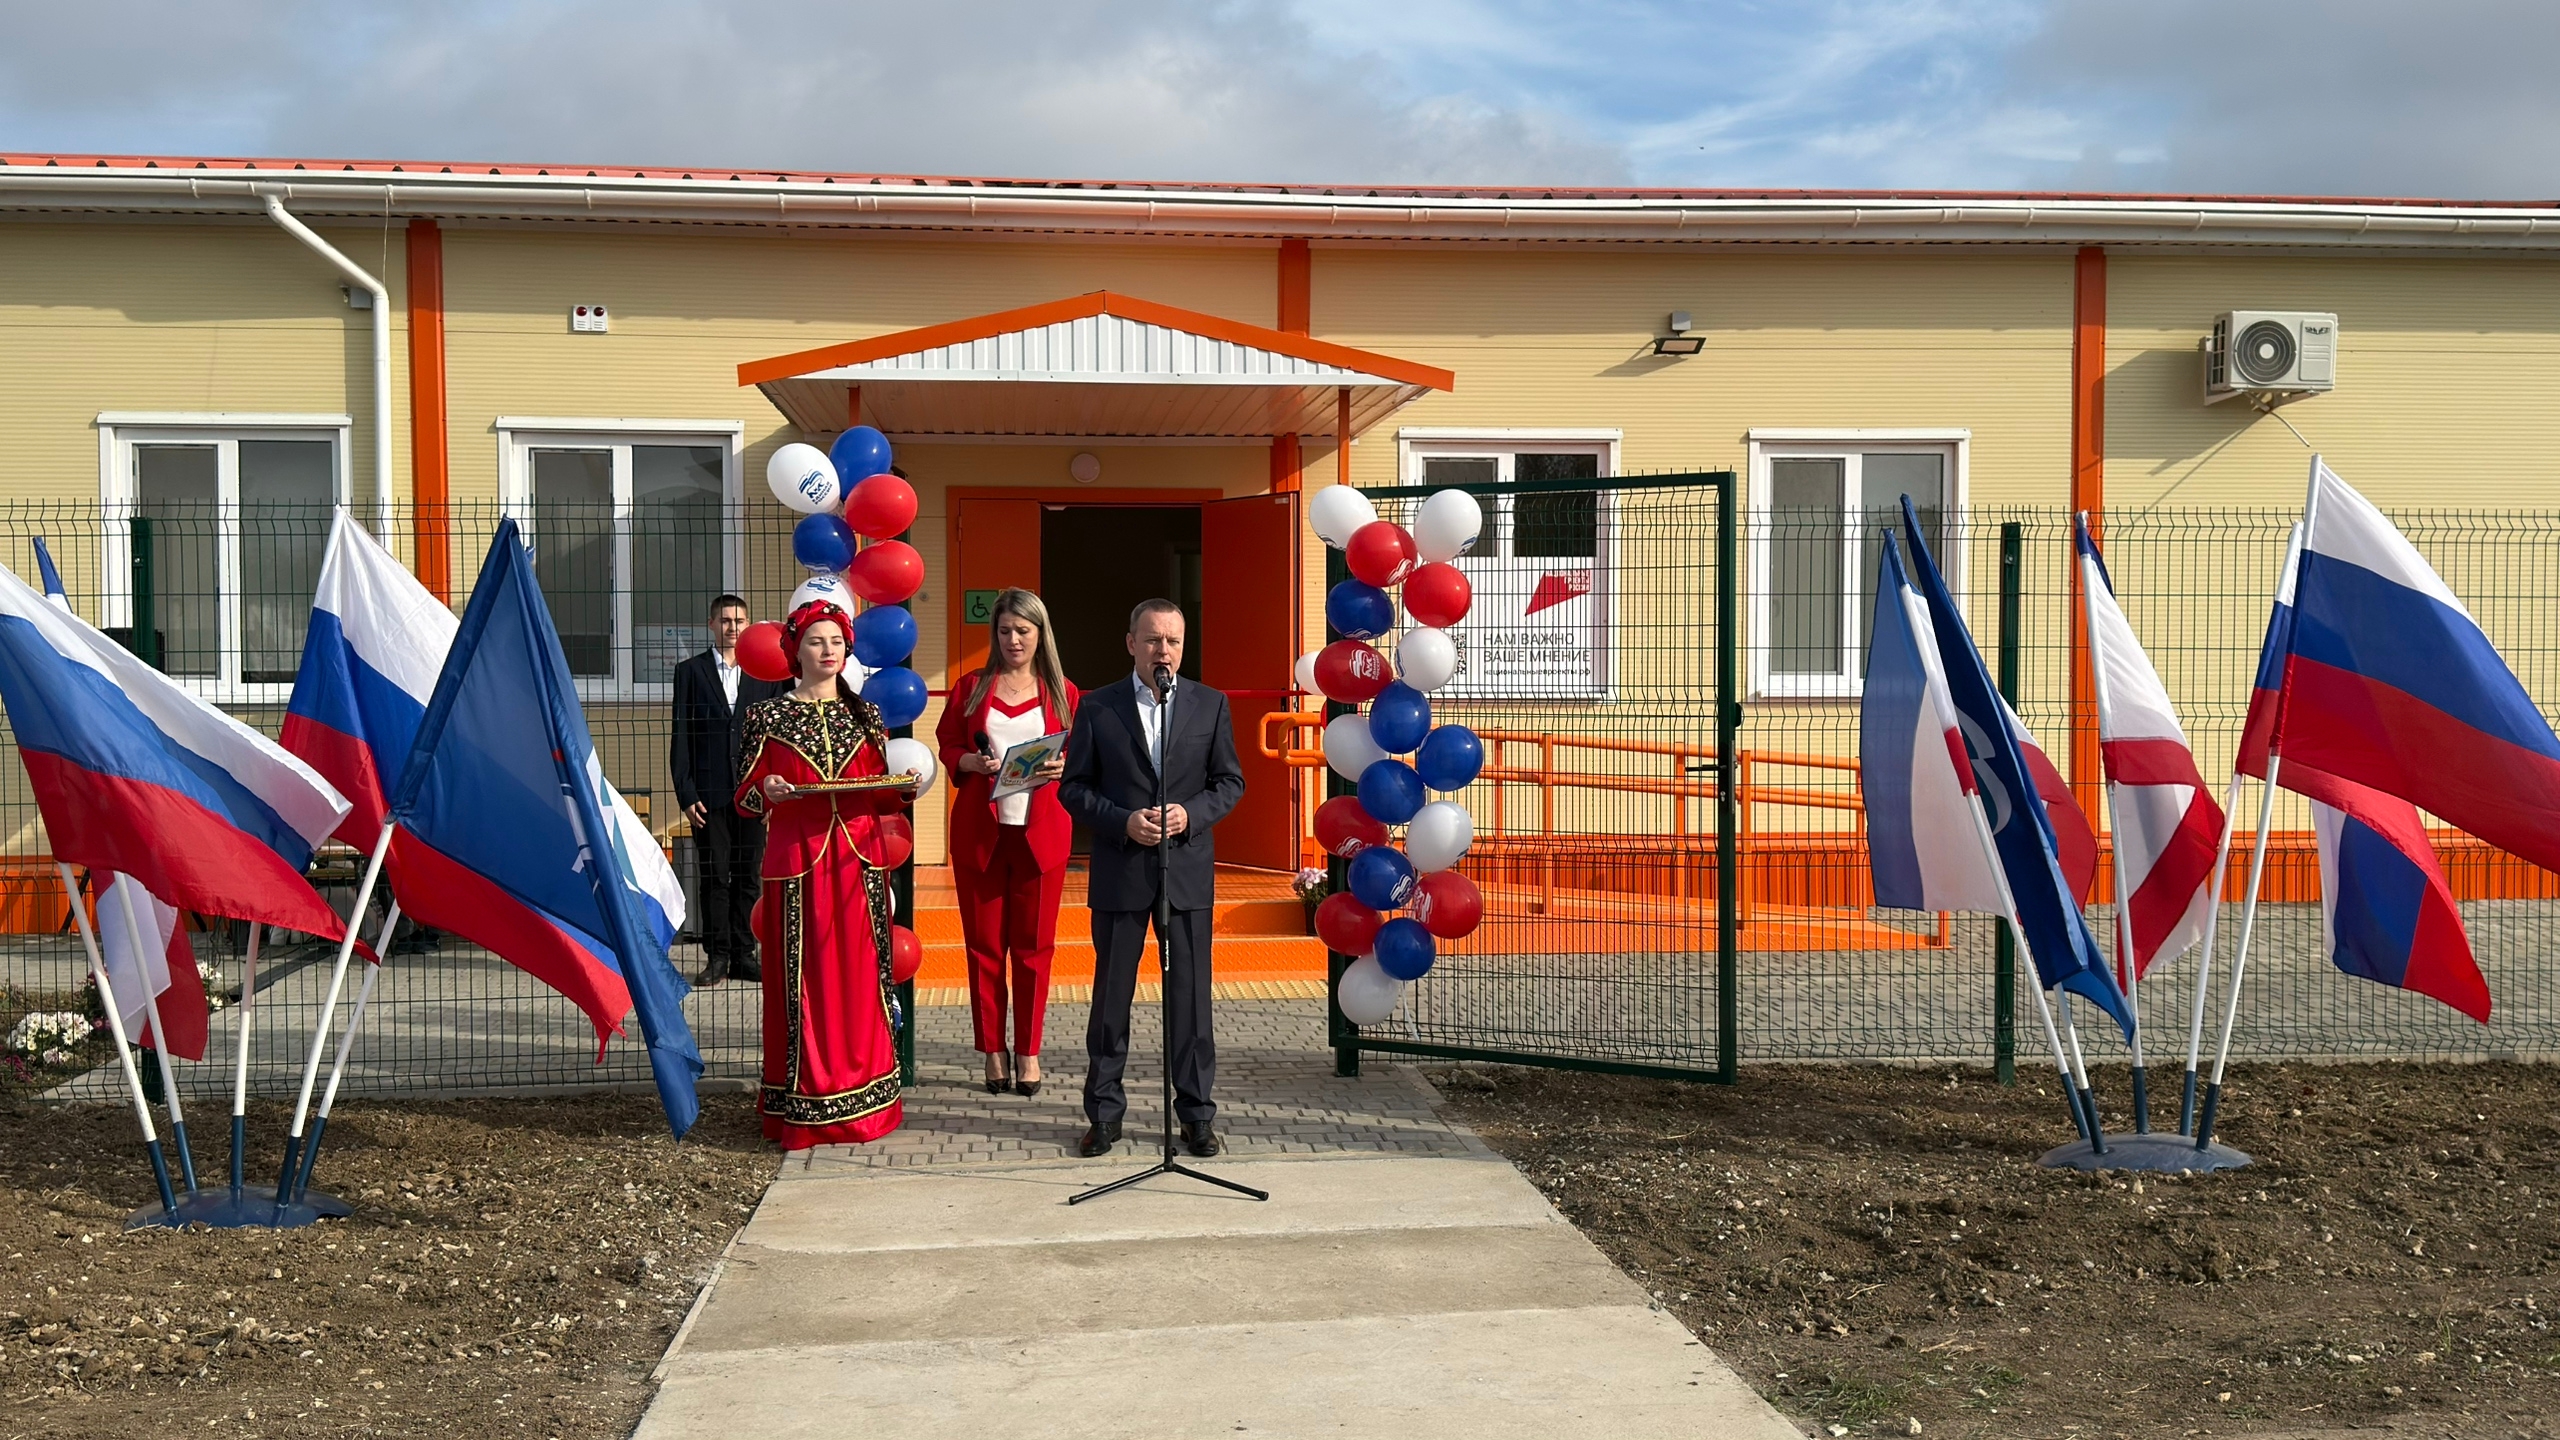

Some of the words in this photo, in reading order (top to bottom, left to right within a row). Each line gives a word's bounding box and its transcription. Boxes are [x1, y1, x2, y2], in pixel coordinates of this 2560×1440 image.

[1484, 633, 1516, 645] НАМ
[1521, 633, 1573, 645] ВАЖНО
[1484, 651, 1524, 662] ВАШЕ
[1530, 650, 1590, 662] МНЕНИЕ
